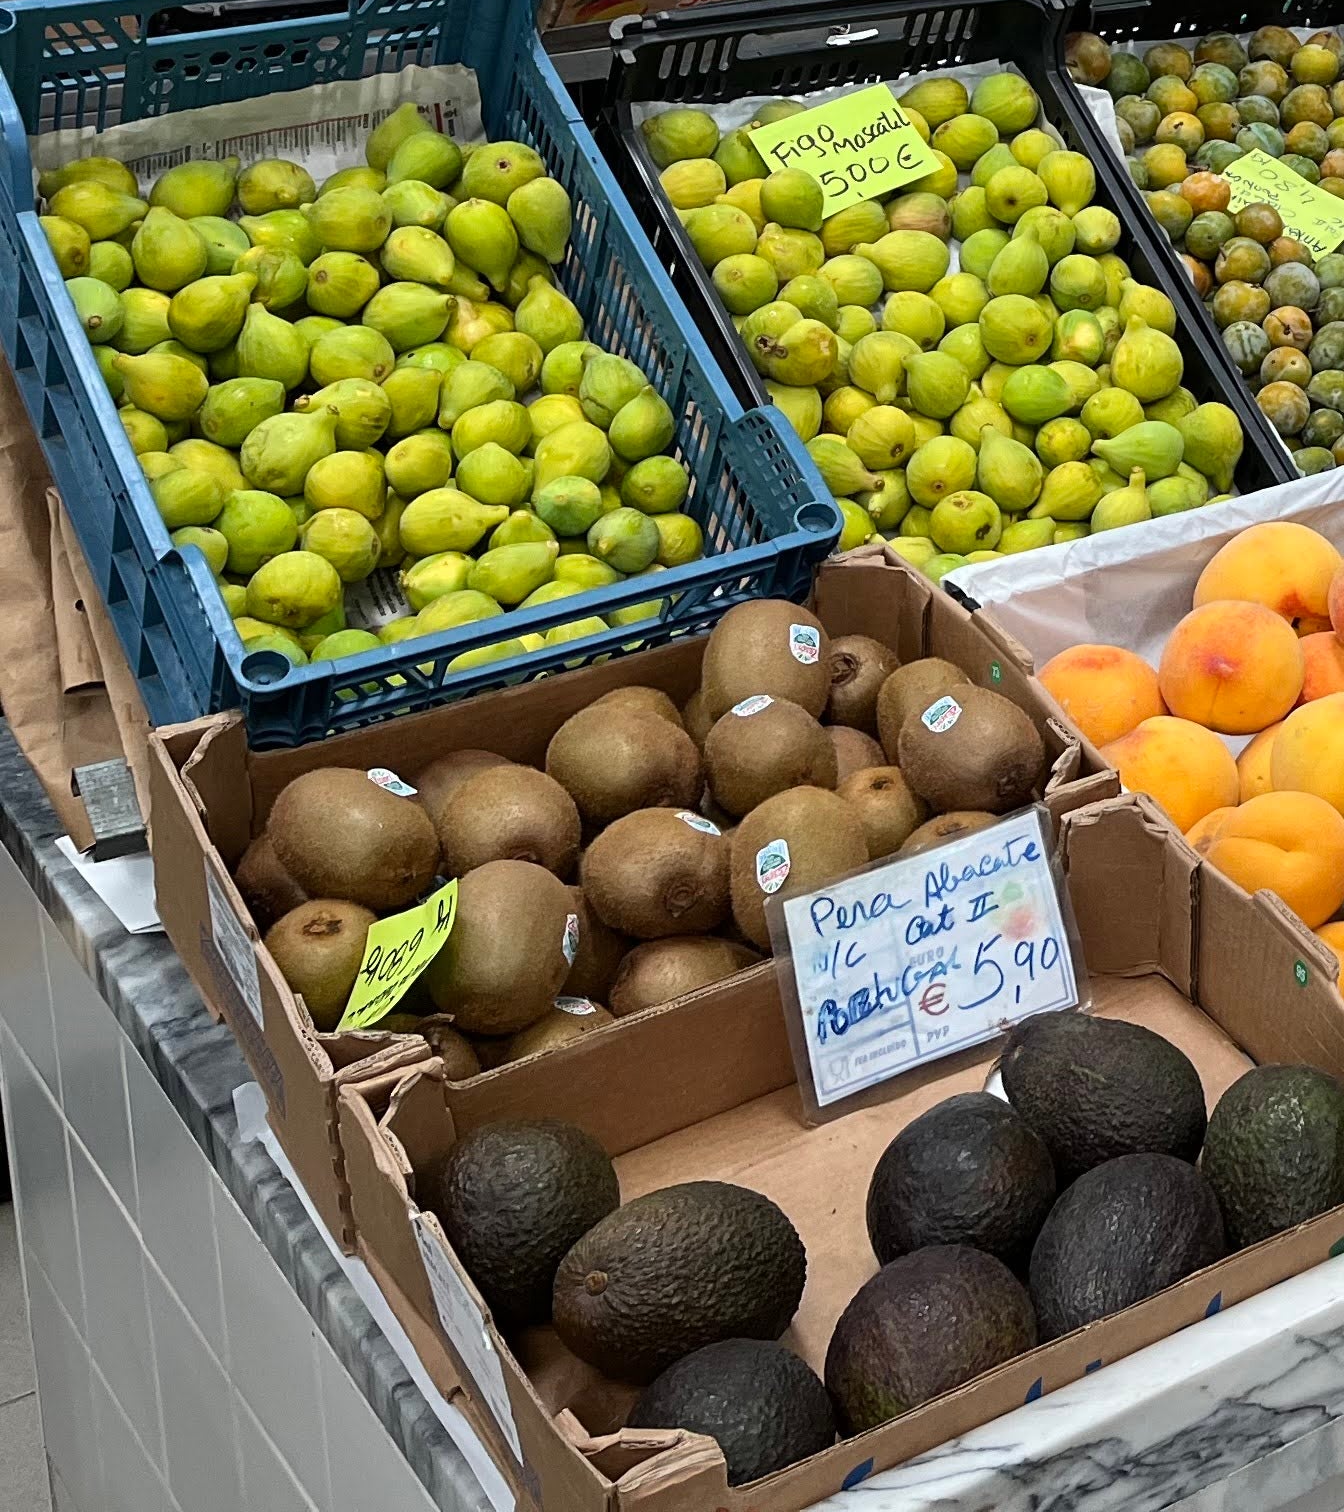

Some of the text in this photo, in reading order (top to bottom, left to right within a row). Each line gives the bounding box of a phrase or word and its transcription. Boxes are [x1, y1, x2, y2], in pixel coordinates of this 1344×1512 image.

[770, 124, 835, 168] Figo
[810, 834, 1041, 937] Pera Abacate
[957, 934, 1060, 1011] 5,90
